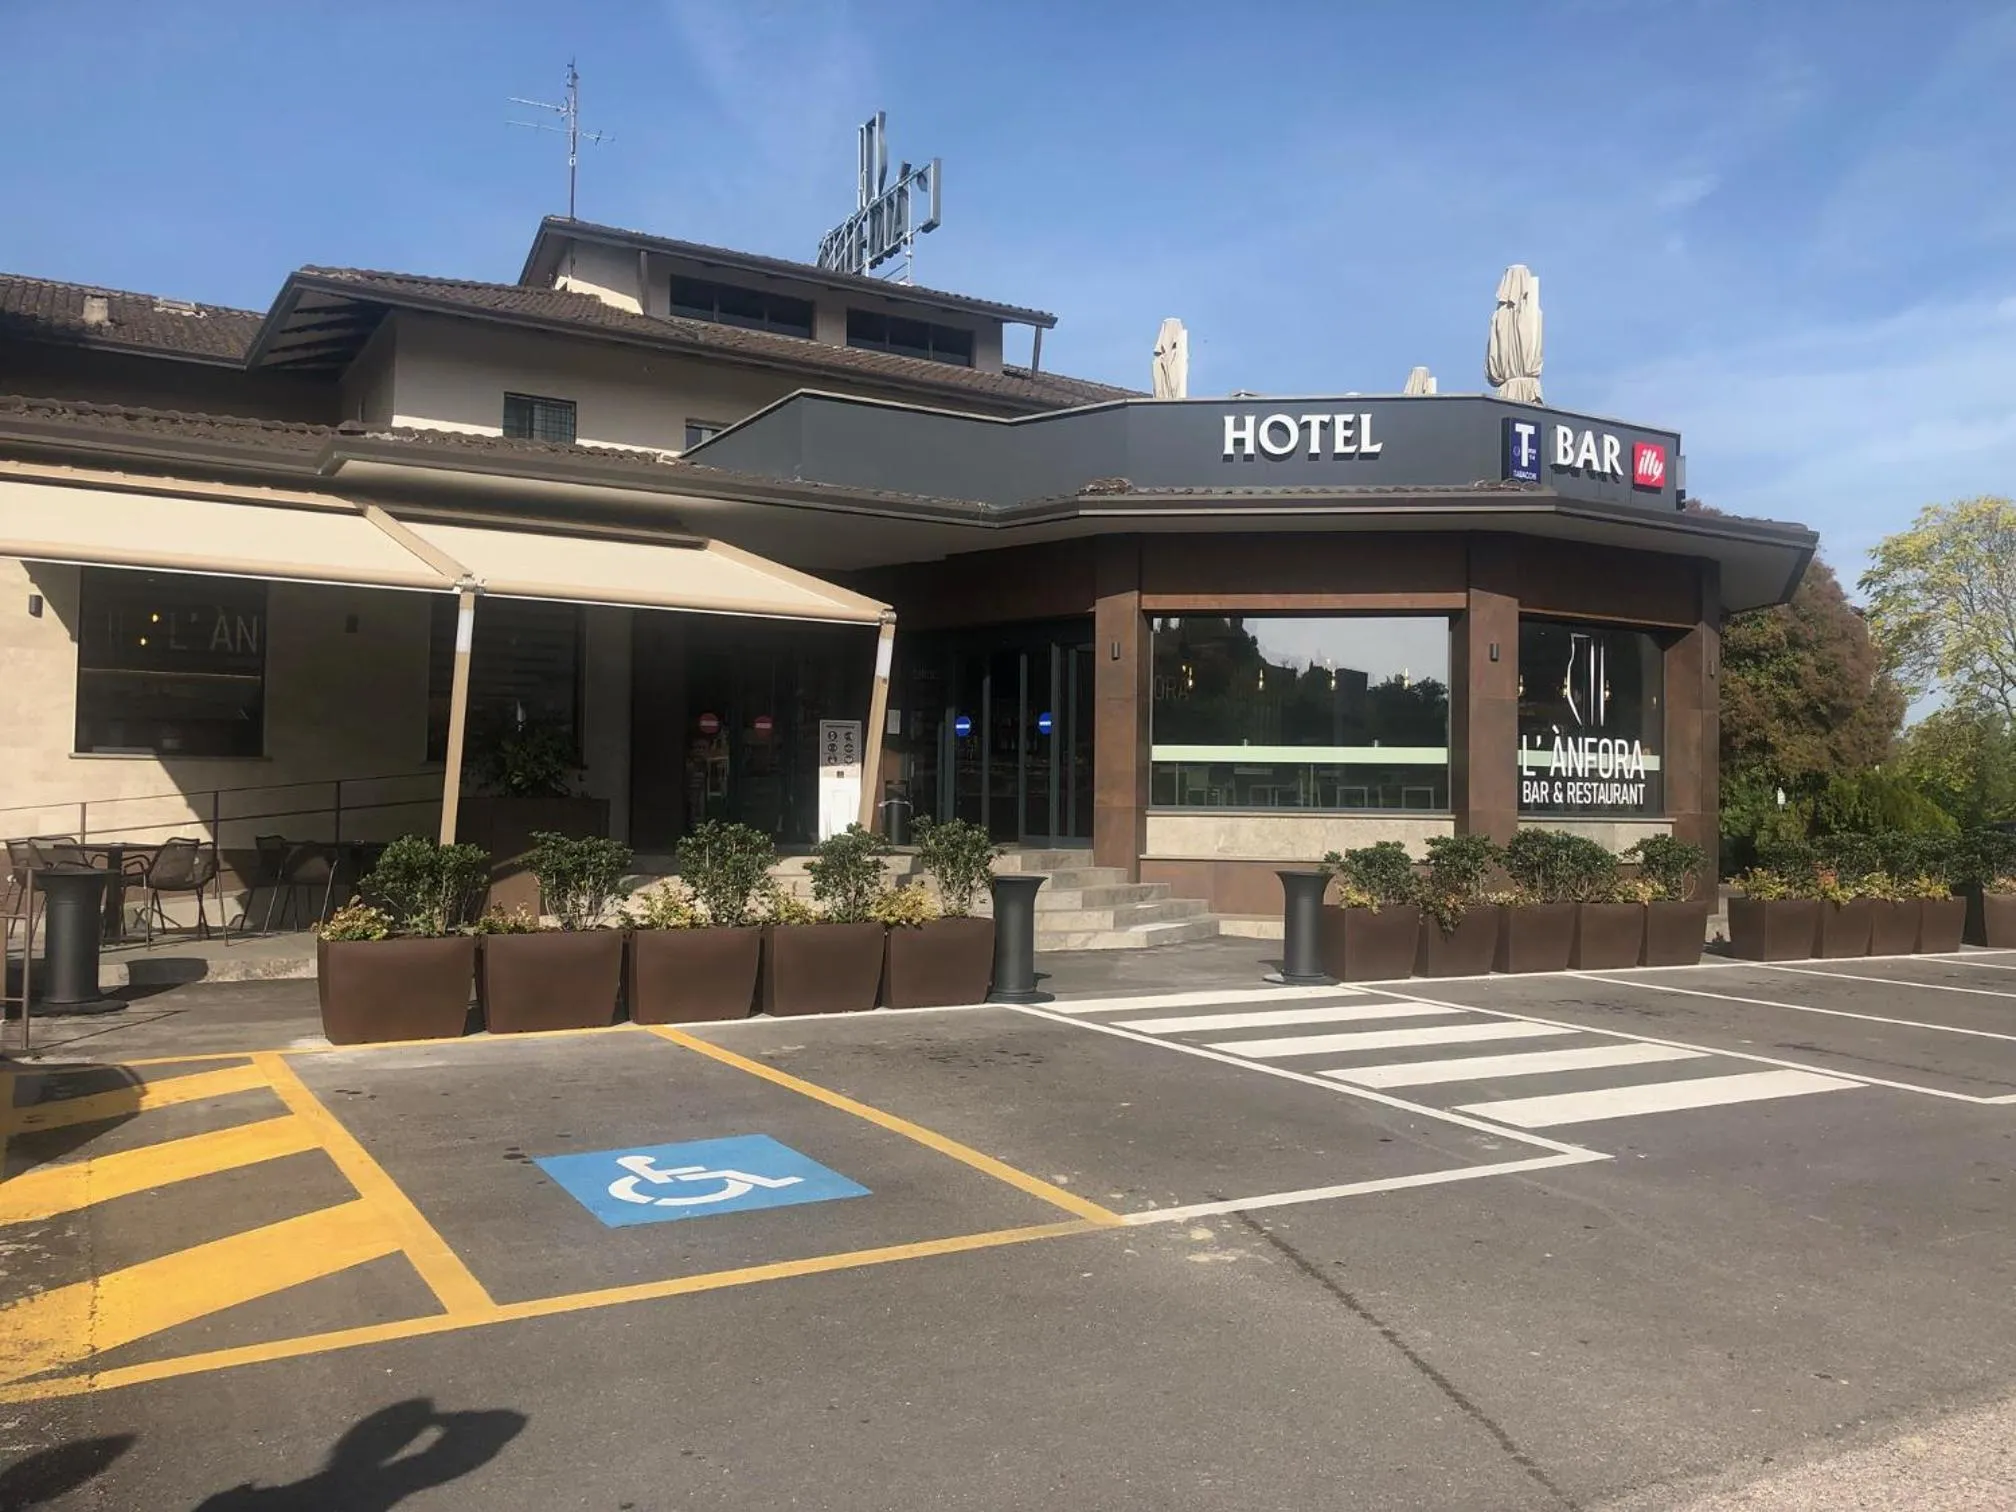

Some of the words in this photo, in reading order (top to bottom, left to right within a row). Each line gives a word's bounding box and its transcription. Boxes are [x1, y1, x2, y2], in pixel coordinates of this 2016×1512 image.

[1222, 413, 1384, 456] HOTEL
[1515, 423, 1535, 467] T
[1556, 425, 1624, 476] BAR
[1638, 449, 1663, 483] illy
[1522, 781, 1549, 803] BAR
[1553, 781, 1564, 803] &
[1567, 782, 1646, 805] RESTAURANT
